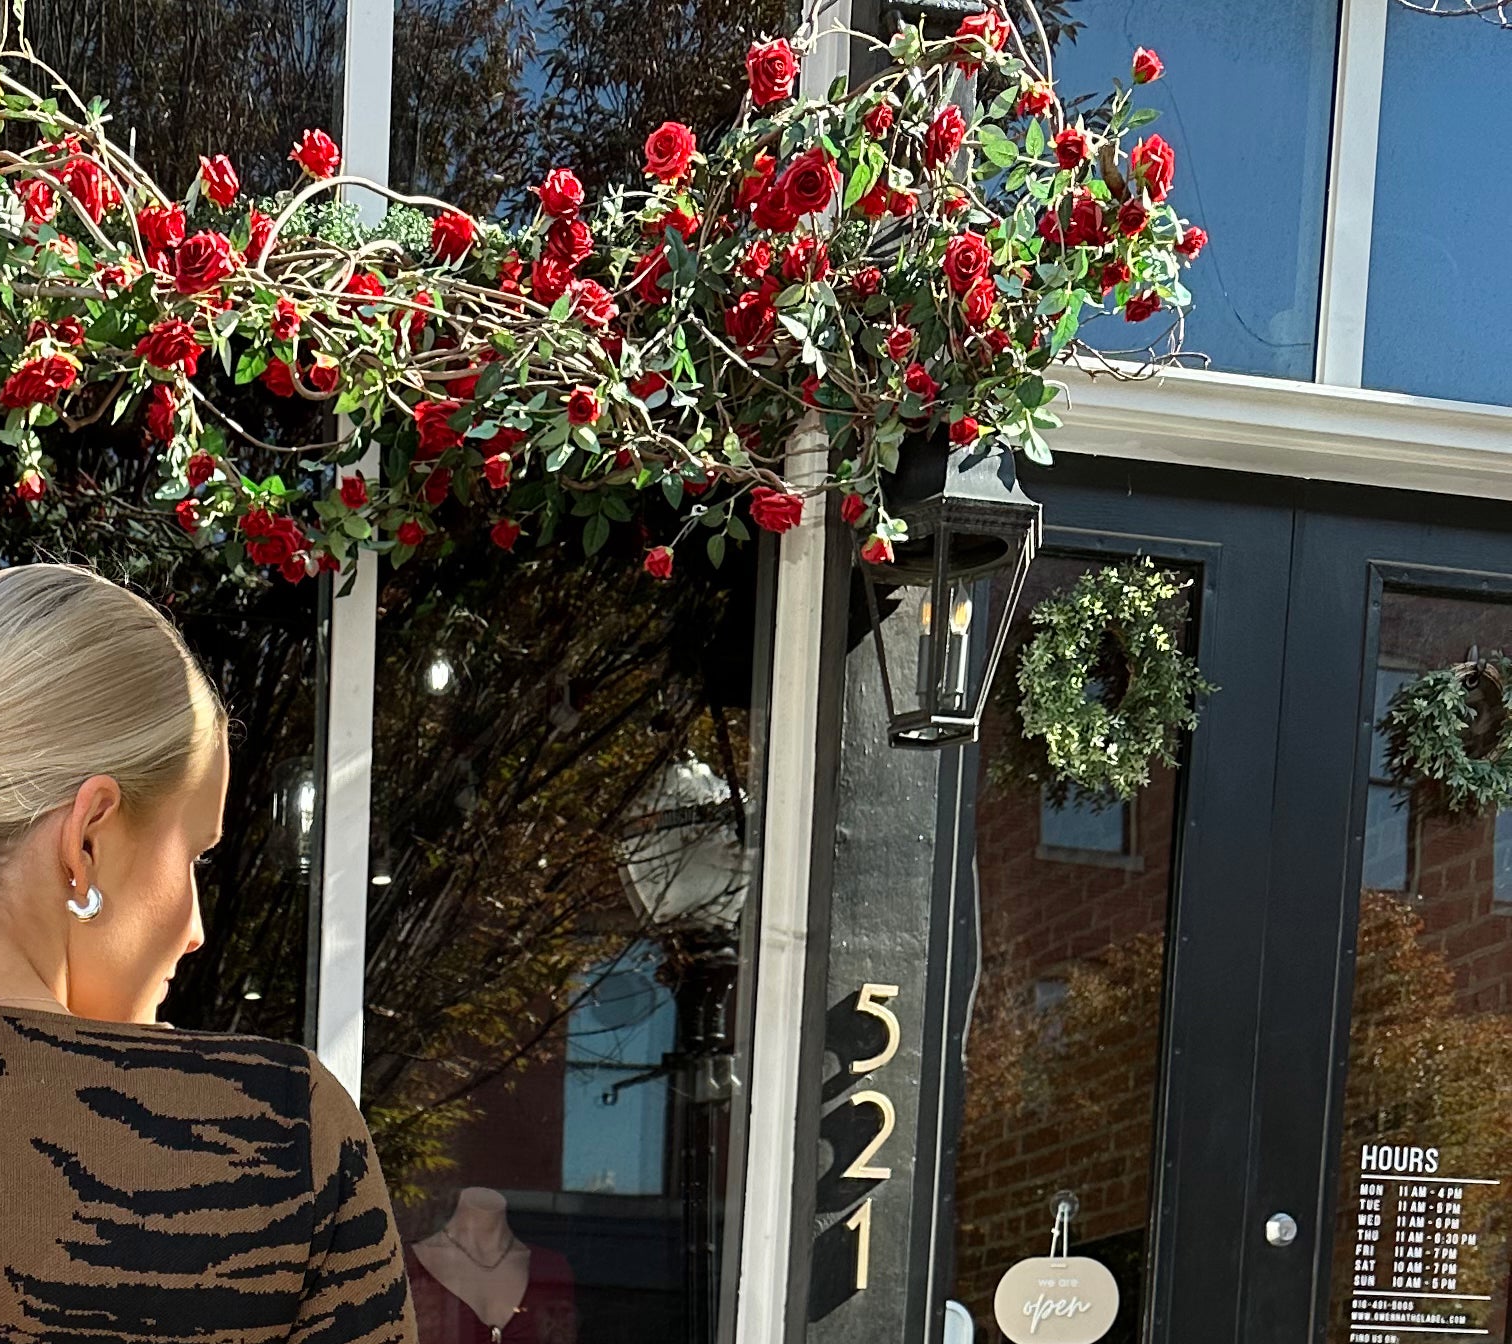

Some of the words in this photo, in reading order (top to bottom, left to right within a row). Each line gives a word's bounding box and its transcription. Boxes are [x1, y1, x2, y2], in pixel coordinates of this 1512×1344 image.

[843, 983, 900, 1289] 521
[1361, 1144, 1439, 1173] HOURS
[1360, 1184, 1384, 1196] MON
[1399, 1186, 1408, 1197] 11
[1411, 1186, 1427, 1198] AM
[1437, 1188, 1444, 1199] 4
[1447, 1188, 1463, 1199] PM
[1359, 1199, 1381, 1211] TUE
[1398, 1200, 1407, 1212] 11
[1410, 1201, 1426, 1213] AM
[1445, 1203, 1461, 1214] PM
[1358, 1214, 1381, 1226] WED
[1397, 1216, 1406, 1227] 11
[1409, 1216, 1425, 1228] AM
[1444, 1218, 1459, 1229] PM
[1357, 1229, 1379, 1241] THU
[1396, 1231, 1405, 1242] 11
[1408, 1231, 1424, 1243] AM
[1461, 1234, 1477, 1245] PM
[1355, 1244, 1374, 1256] FRI
[1395, 1246, 1404, 1258] 11
[1407, 1246, 1422, 1258] AM
[1433, 1248, 1441, 1259] 7
[1442, 1248, 1457, 1259] PM
[1354, 1259, 1376, 1271] SAT
[1393, 1261, 1405, 1273] 10
[1407, 1261, 1422, 1273] AM
[1433, 1262, 1440, 1274] 7
[1441, 1263, 1457, 1274] PM
[1038, 1279, 1056, 1288] we
[1058, 1279, 1080, 1288] are
[1354, 1275, 1375, 1287] SUN
[1392, 1276, 1404, 1288] 10
[1406, 1277, 1421, 1288] AM
[1441, 1278, 1456, 1290] PM
[1023, 1293, 1092, 1334] open
[1372, 1334, 1383, 1343] US
